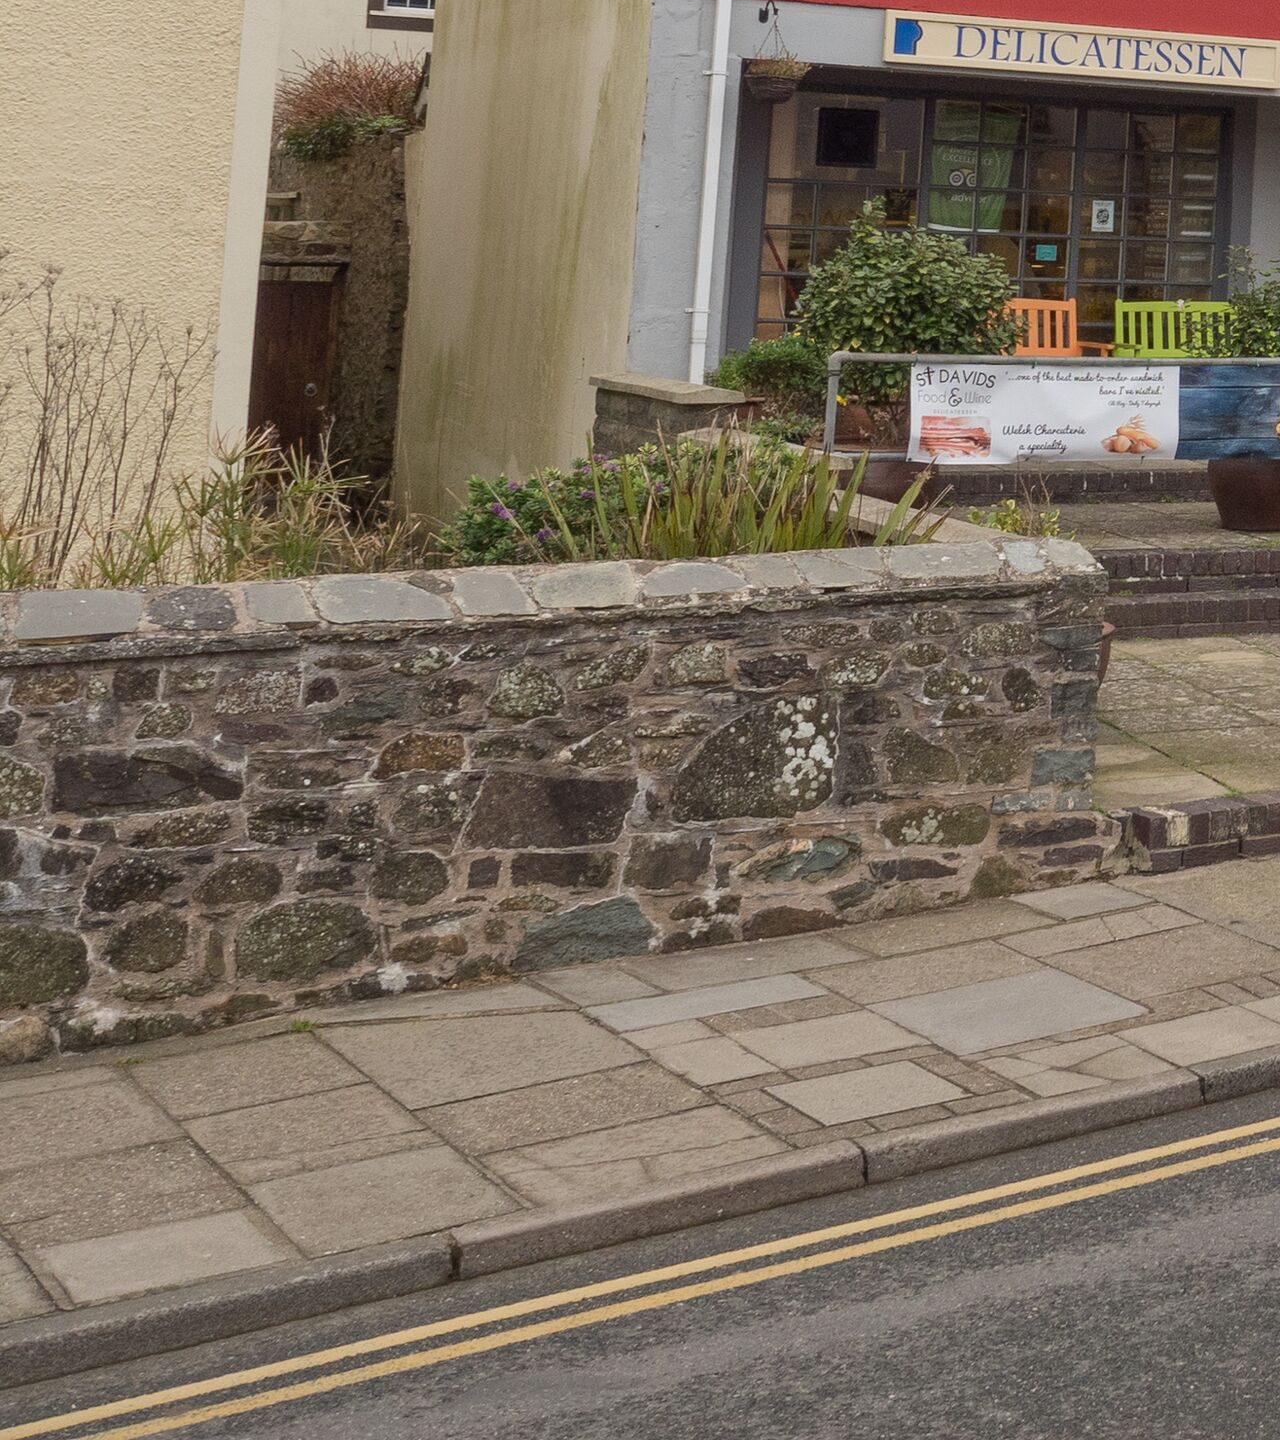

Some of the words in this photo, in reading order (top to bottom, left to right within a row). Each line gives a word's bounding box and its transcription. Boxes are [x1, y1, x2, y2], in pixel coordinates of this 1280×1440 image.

[954, 25, 1246, 78] DELICATESSEN
[939, 369, 996, 389] DAVIDS
[1032, 372, 1041, 383] of
[1042, 371, 1055, 382] the
[1056, 372, 1072, 382] best
[1131, 372, 1163, 382] sandwich
[917, 390, 946, 403] Food
[948, 388, 962, 407] &
[964, 391, 992, 404] Wine
[1099, 385, 1118, 395] bars
[1002, 424, 1032, 435] Welsh
[1034, 424, 1087, 435] Charcuterie
[1027, 439, 1067, 454] speciality
